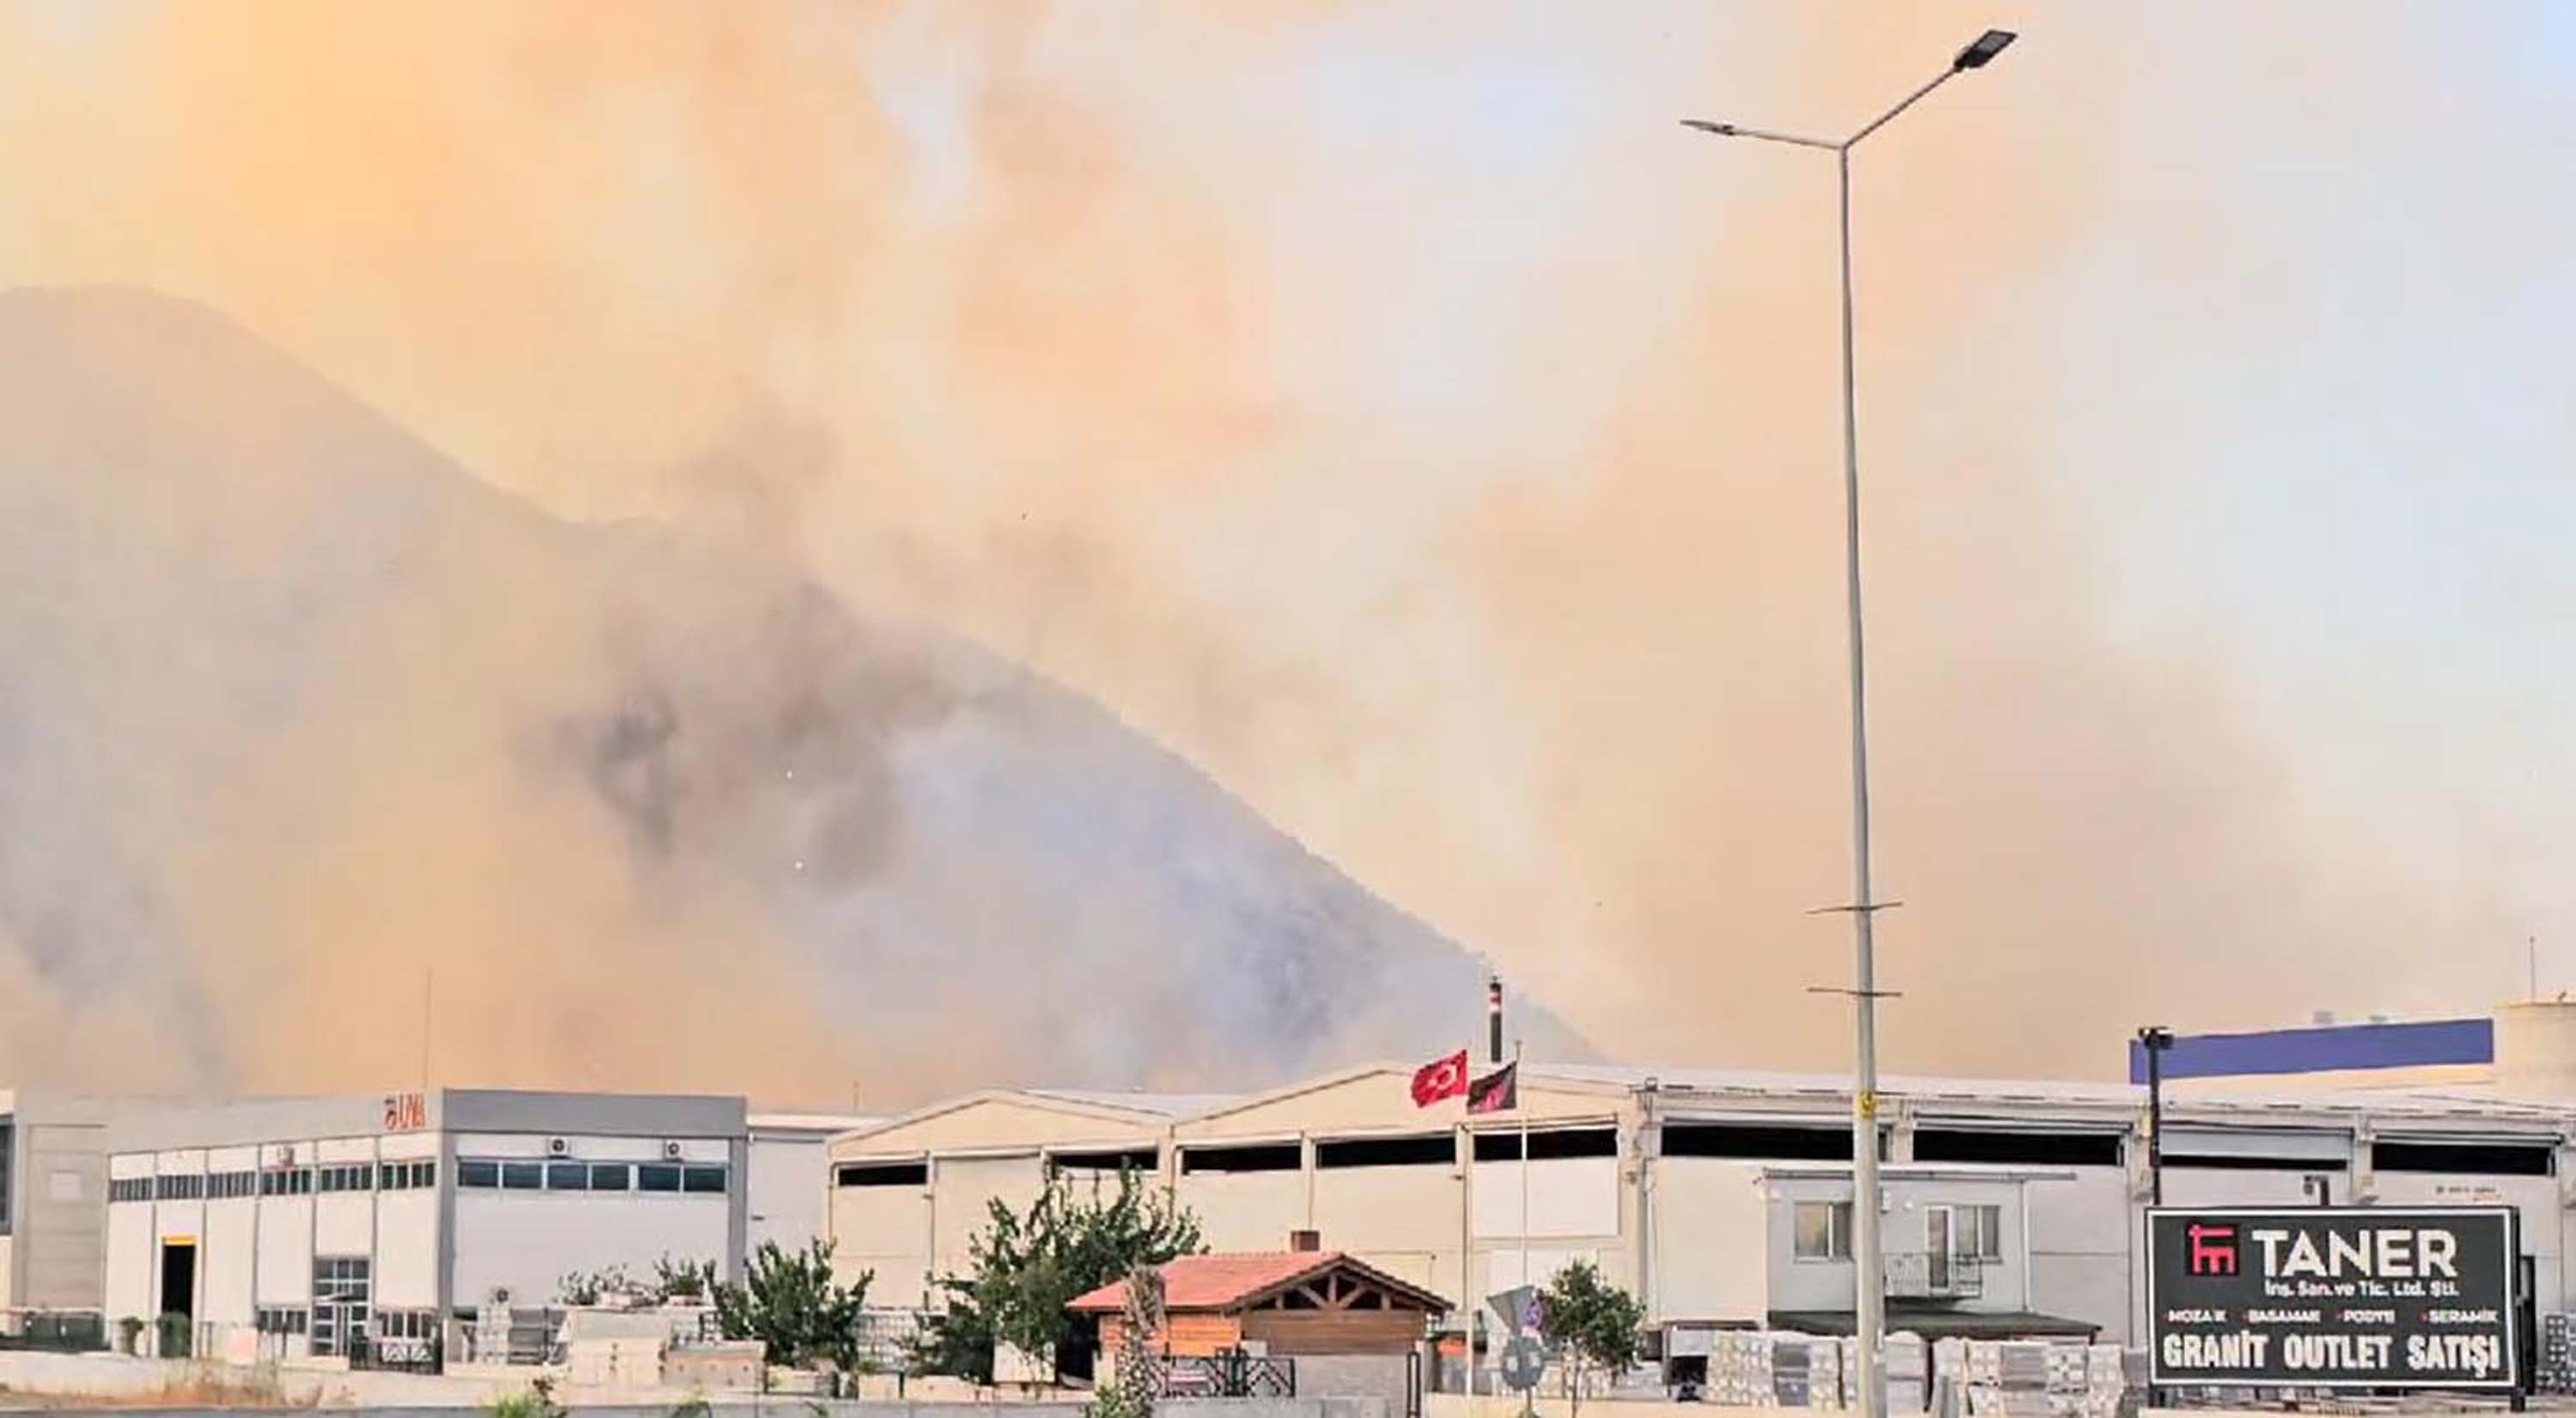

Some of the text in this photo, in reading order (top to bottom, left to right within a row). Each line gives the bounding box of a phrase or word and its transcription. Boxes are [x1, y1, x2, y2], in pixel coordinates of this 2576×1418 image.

[2251, 1229, 2458, 1277] TANER
[2392, 1280, 2426, 1297] Ltd.
[2163, 1330, 2500, 1378] GRANİT OUTLET SATIŞI
